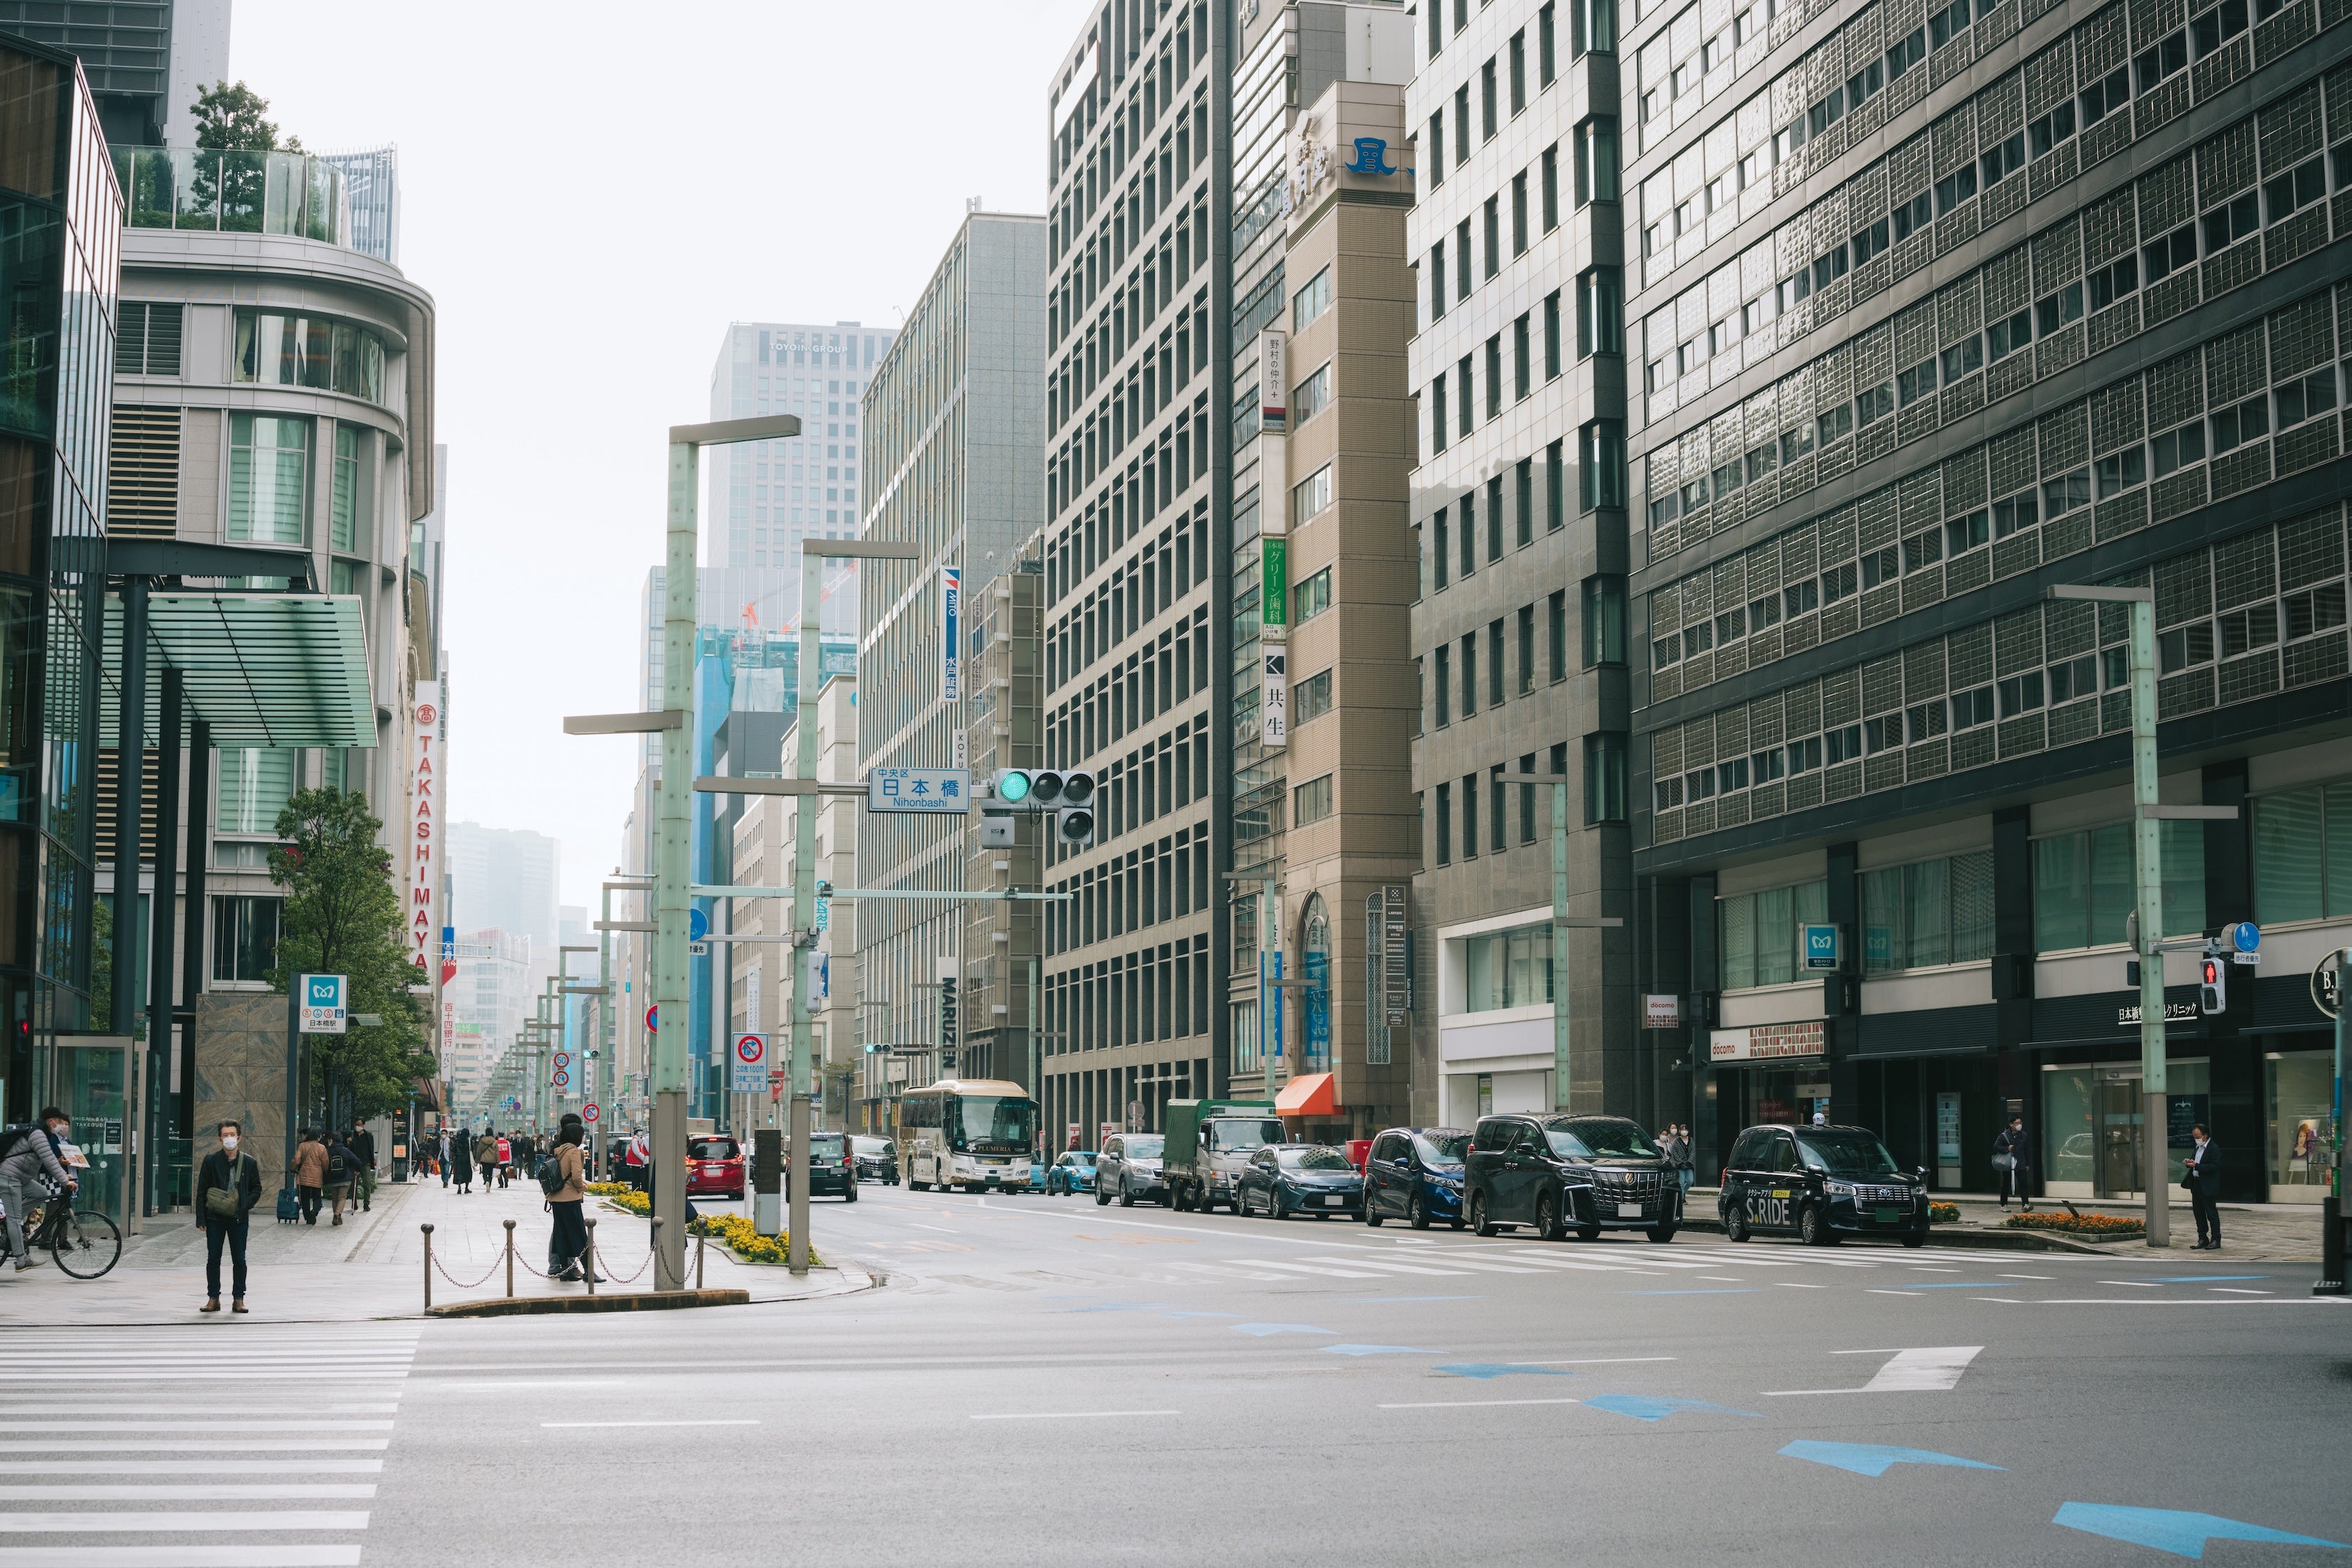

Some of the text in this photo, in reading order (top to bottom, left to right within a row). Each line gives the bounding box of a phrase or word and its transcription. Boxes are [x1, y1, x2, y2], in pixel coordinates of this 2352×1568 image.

[1269, 551, 1281, 624] グリーン歯科
[946, 656, 956, 698] 水戸証券
[1266, 688, 1284, 736] 共生
[878, 768, 909, 778] 中央区
[884, 778, 959, 798] 日本橋
[893, 798, 947, 807] Nihonbashi
[414, 735, 432, 969] TAKASHIMAYA
[444, 1003, 453, 1047] 百十四銀行
[943, 977, 956, 1068] MARUZEN
[1713, 1044, 1735, 1055] docomo
[1747, 1188, 1772, 1197] タクシーアプリ
[1746, 1197, 1790, 1225] S.RIDE
